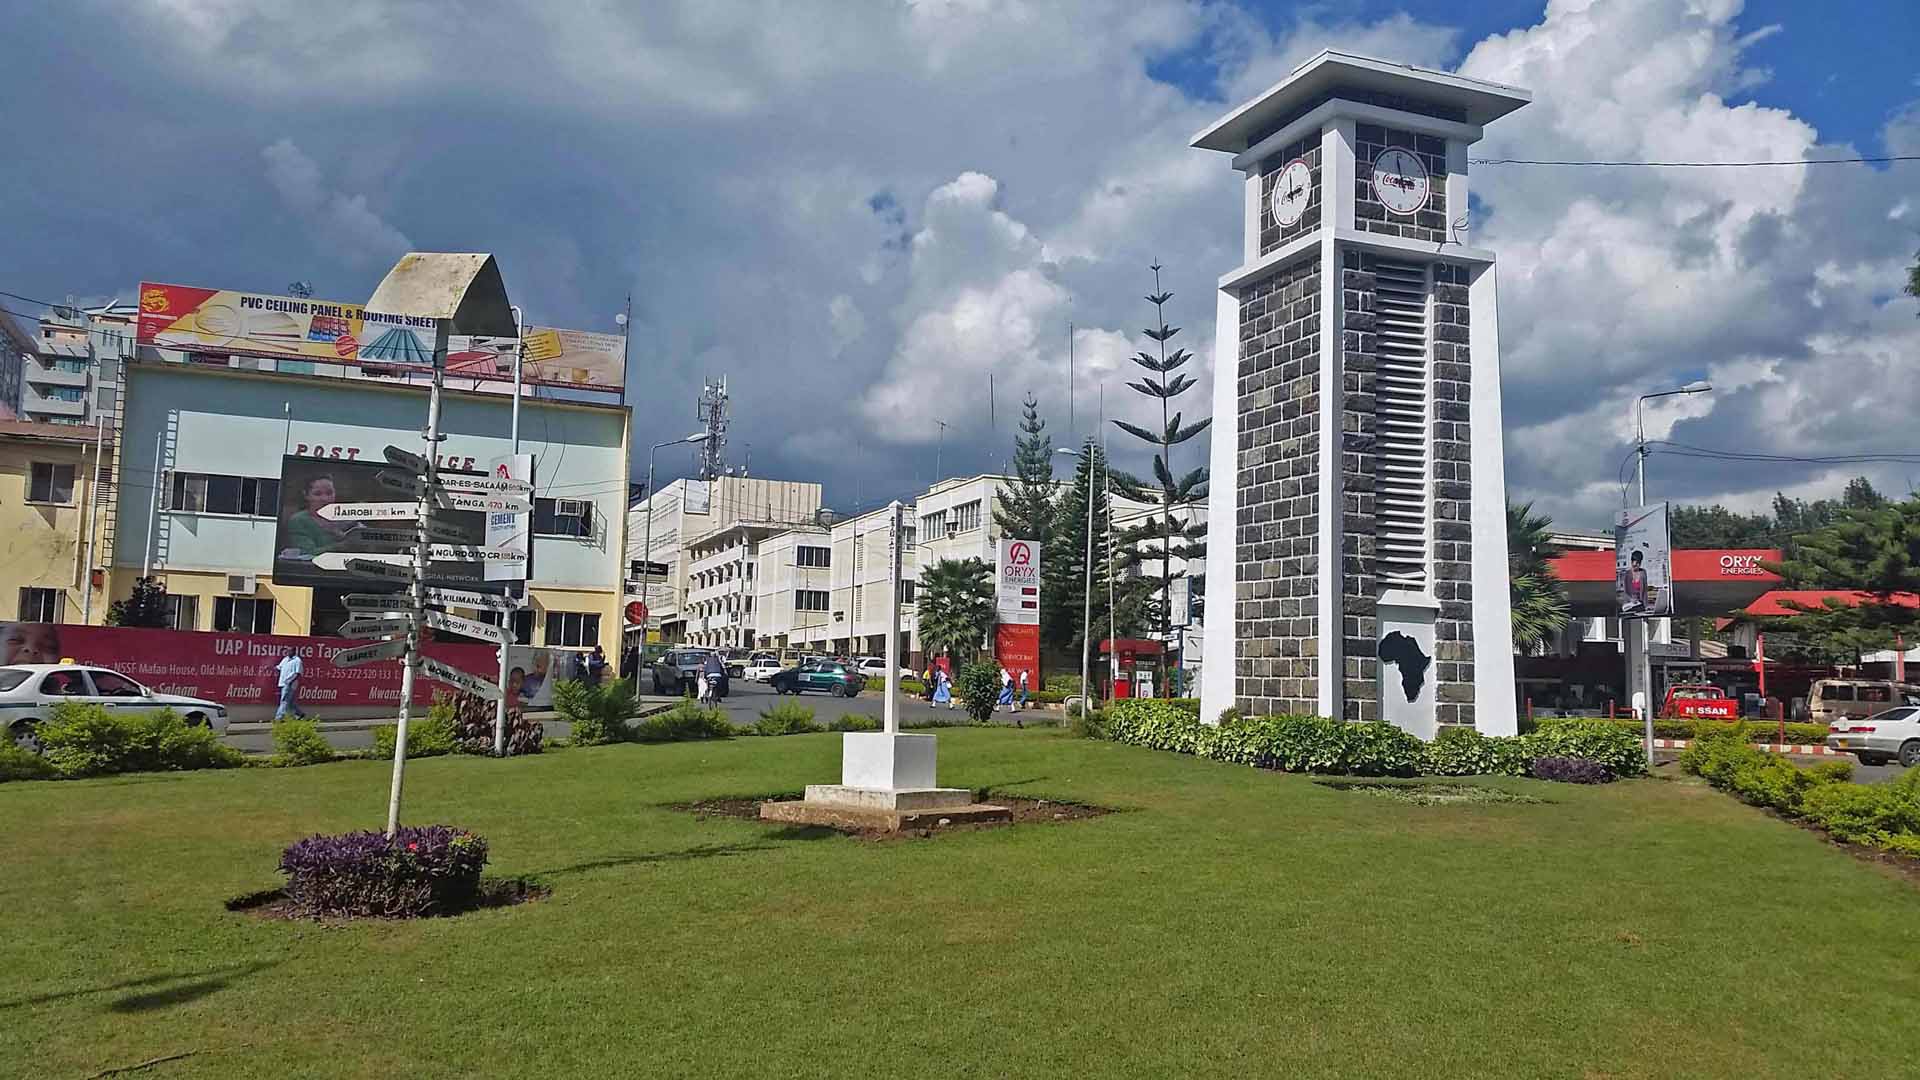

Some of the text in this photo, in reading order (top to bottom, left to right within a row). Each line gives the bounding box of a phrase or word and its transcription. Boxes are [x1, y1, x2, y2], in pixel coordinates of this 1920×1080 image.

[240, 296, 263, 310] PVC
[265, 298, 308, 315] CEILING
[310, 304, 342, 319] PANEL
[345, 309, 353, 319] &
[294, 444, 361, 461] POST
[451, 497, 485, 508] TANGA
[505, 501, 519, 511] km
[391, 507, 406, 516] km
[435, 549, 487, 559] NGURDOTO
[511, 552, 525, 561] km
[1720, 555, 1763, 568] ORYX
[1004, 566, 1036, 577] ORYX
[1721, 567, 1764, 575] ENERGIES
[443, 594, 498, 608] KILIMANJARO
[437, 618, 468, 632] MOSHI
[484, 627, 498, 639] km
[215, 639, 243, 656] UAP
[247, 640, 313, 658] Insurace
[114, 661, 137, 674] NSSF
[226, 684, 262, 698] Arusha
[299, 686, 338, 700] Dodoma
[470, 680, 486, 694] km
